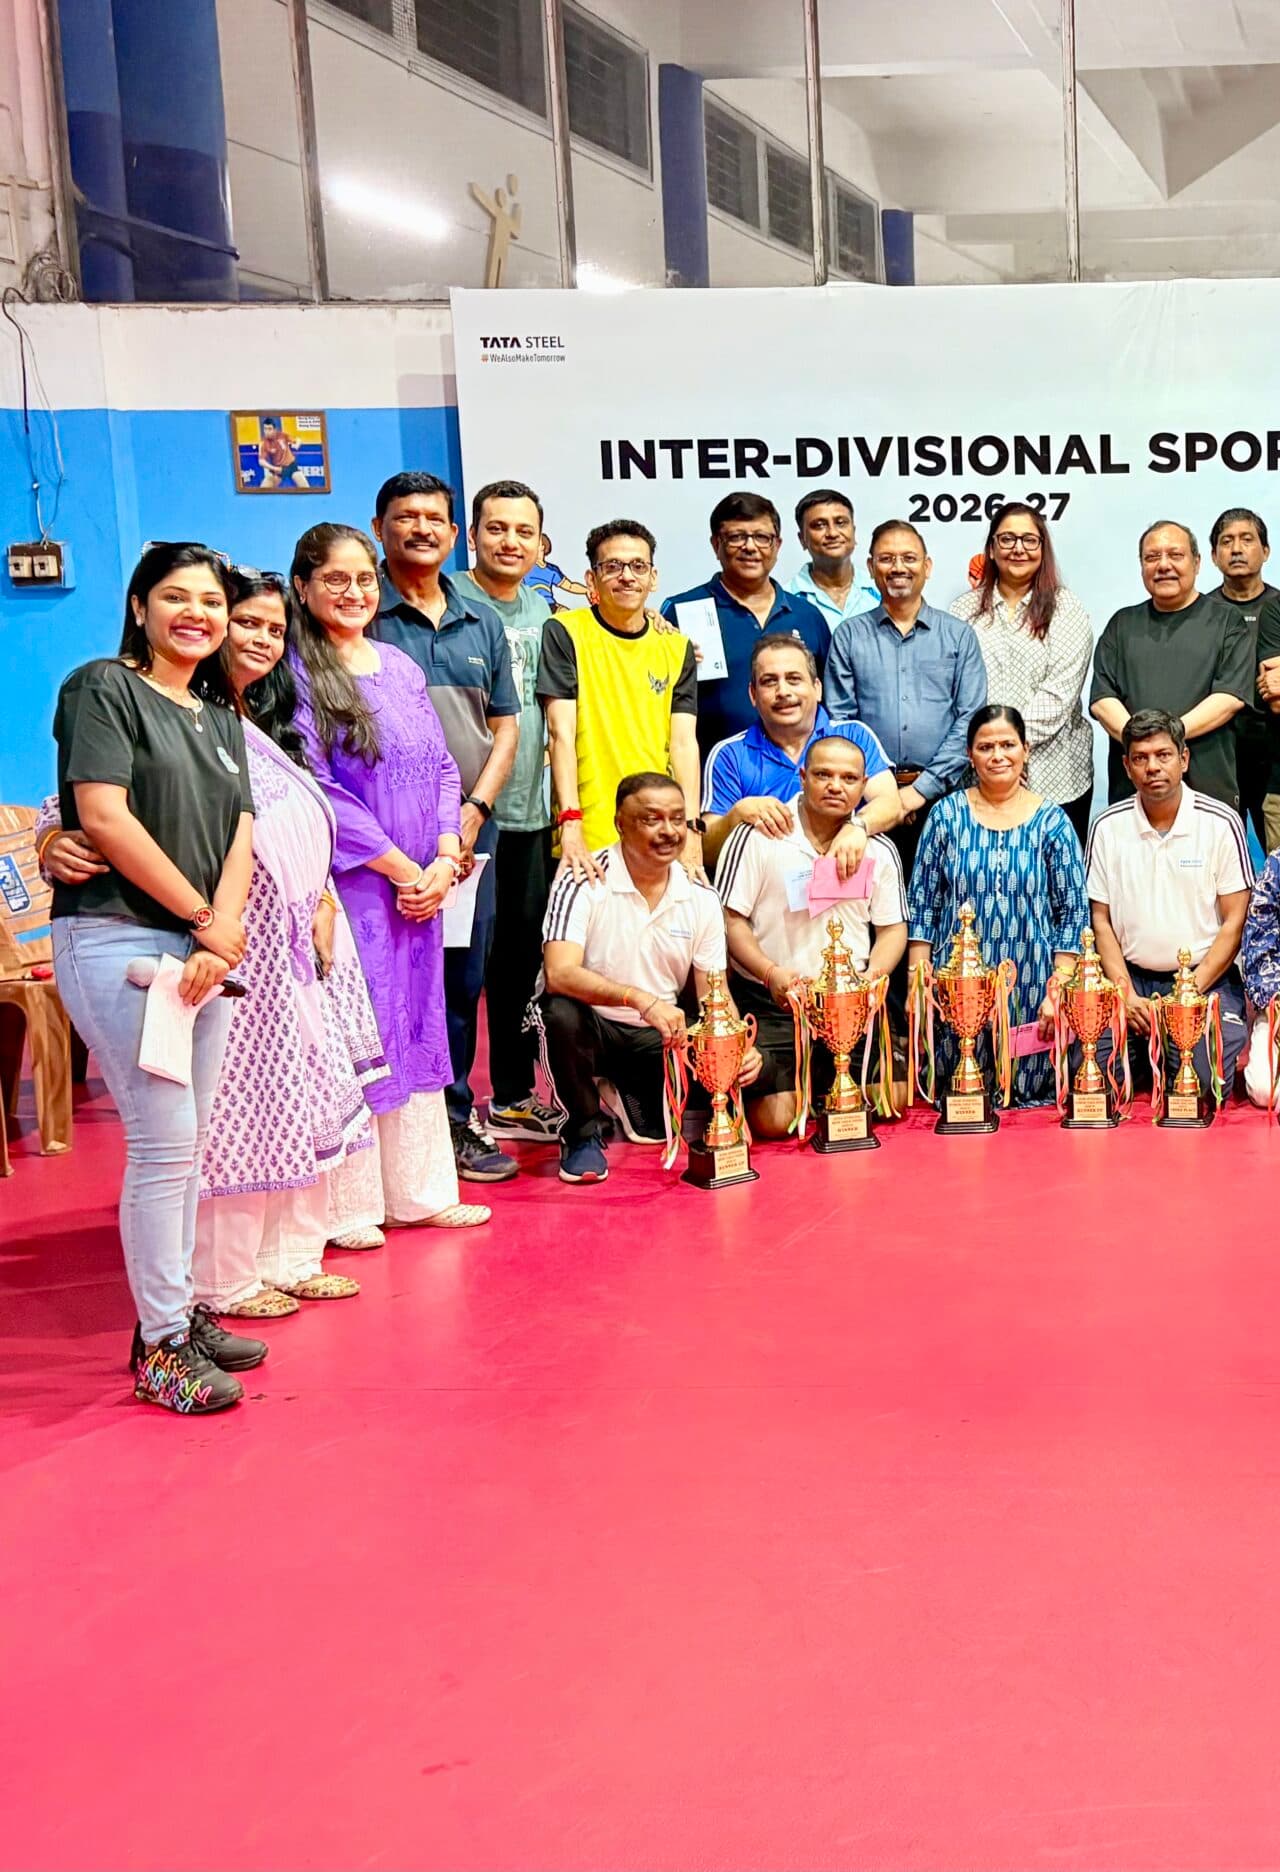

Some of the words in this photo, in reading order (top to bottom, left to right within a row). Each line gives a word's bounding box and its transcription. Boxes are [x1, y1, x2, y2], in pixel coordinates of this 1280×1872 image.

[480, 337, 522, 348] TATA
[525, 336, 565, 348] STEEL
[600, 434, 1130, 480] INTER-DIVISIONAL
